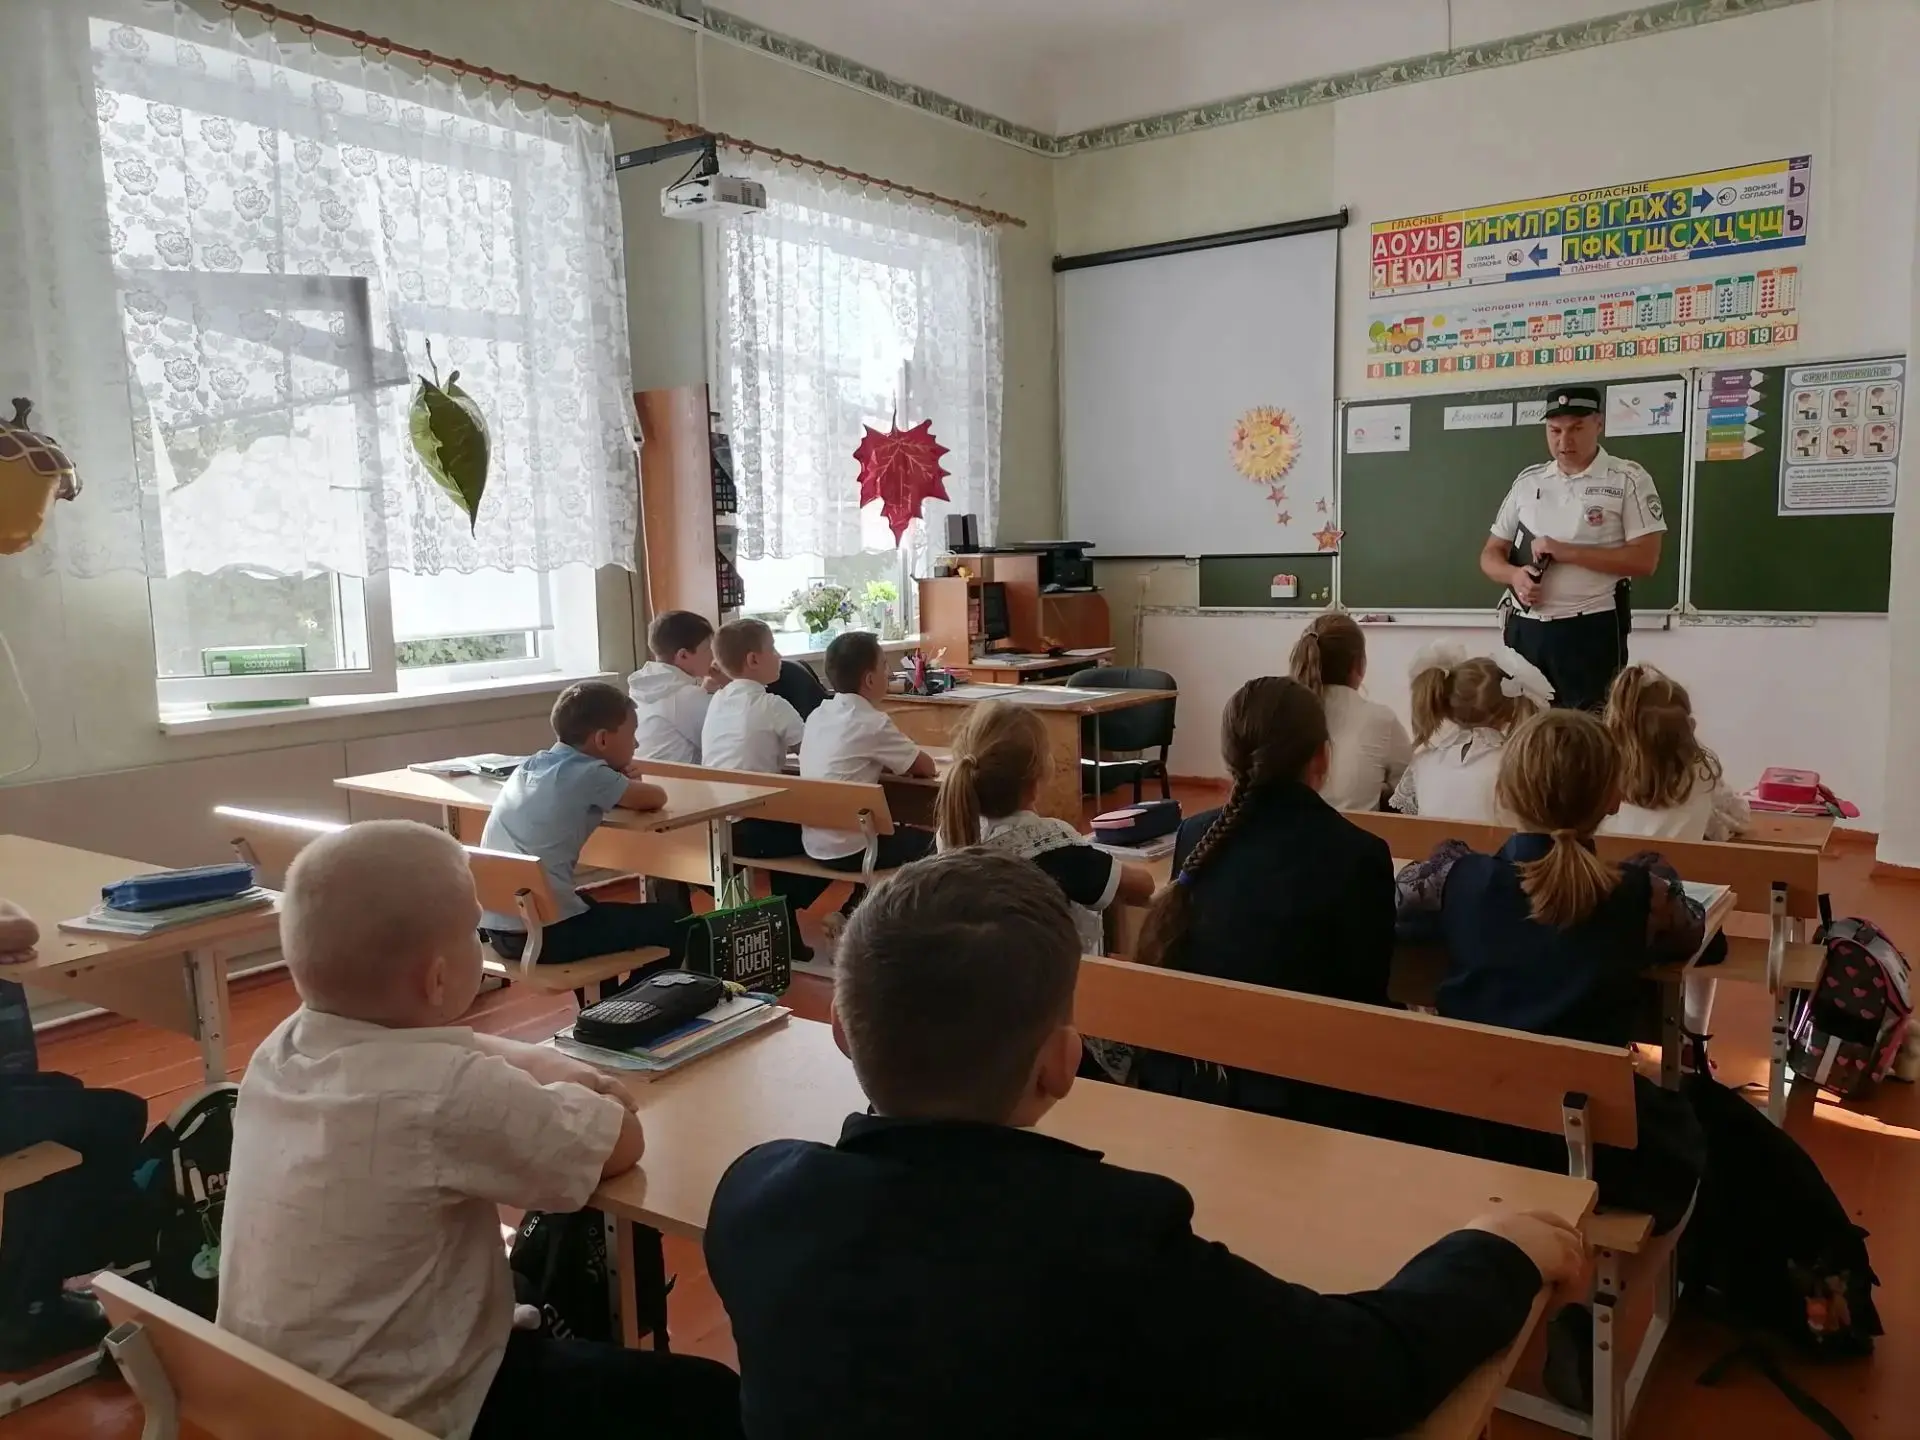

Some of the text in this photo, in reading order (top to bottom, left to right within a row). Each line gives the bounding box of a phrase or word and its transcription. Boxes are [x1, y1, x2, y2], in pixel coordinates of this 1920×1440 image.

[1569, 183, 1649, 203] СОГЛАСНЫЕ
[1391, 215, 1443, 230] ГЛАСНЫЕ
[1571, 253, 1678, 273] ПАРНЫЕ СОГЛАСНЫЕ
[1555, 295, 1595, 305] СОСТАВ
[1600, 290, 1636, 300] ЧИСЛА
[1373, 326, 1794, 377] 0 1 2 3 4 5 6 7 8 9 10 11 12 13 14 15 16 17 18 19 20
[736, 929, 769, 956] GAME
[736, 949, 770, 977] OVER
